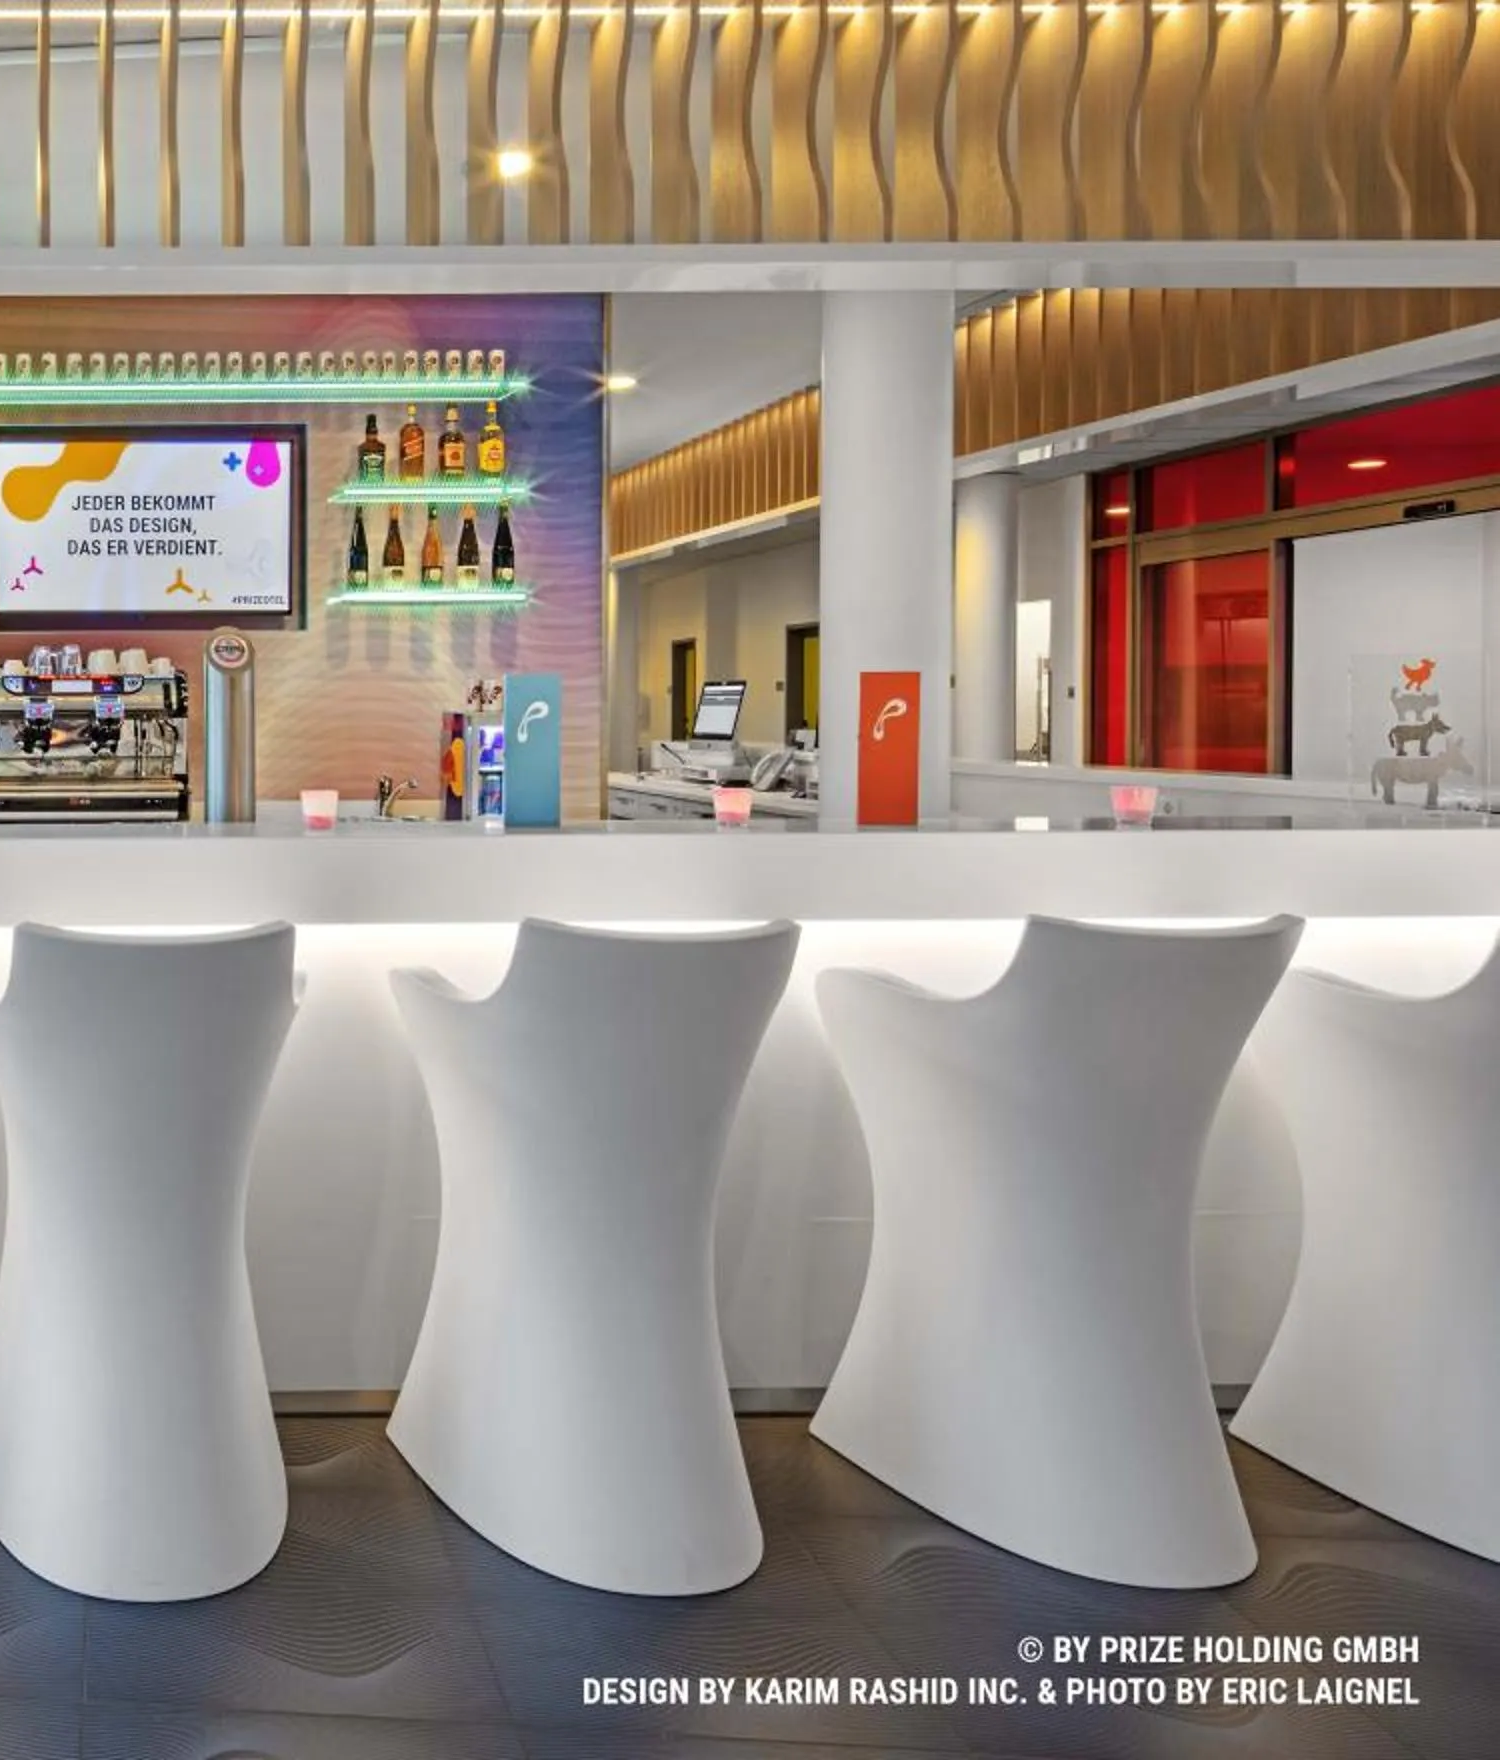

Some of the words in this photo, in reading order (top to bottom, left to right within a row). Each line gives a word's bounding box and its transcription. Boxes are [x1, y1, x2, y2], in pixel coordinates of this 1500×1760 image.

[71, 495, 125, 511] JEDER
[131, 495, 216, 511] BEKOMMT
[90, 517, 124, 533] DAS
[129, 517, 197, 535] DESIGN,
[67, 539, 102, 555] DAS
[107, 539, 129, 555] ER
[133, 539, 223, 556] VERDIENT.
